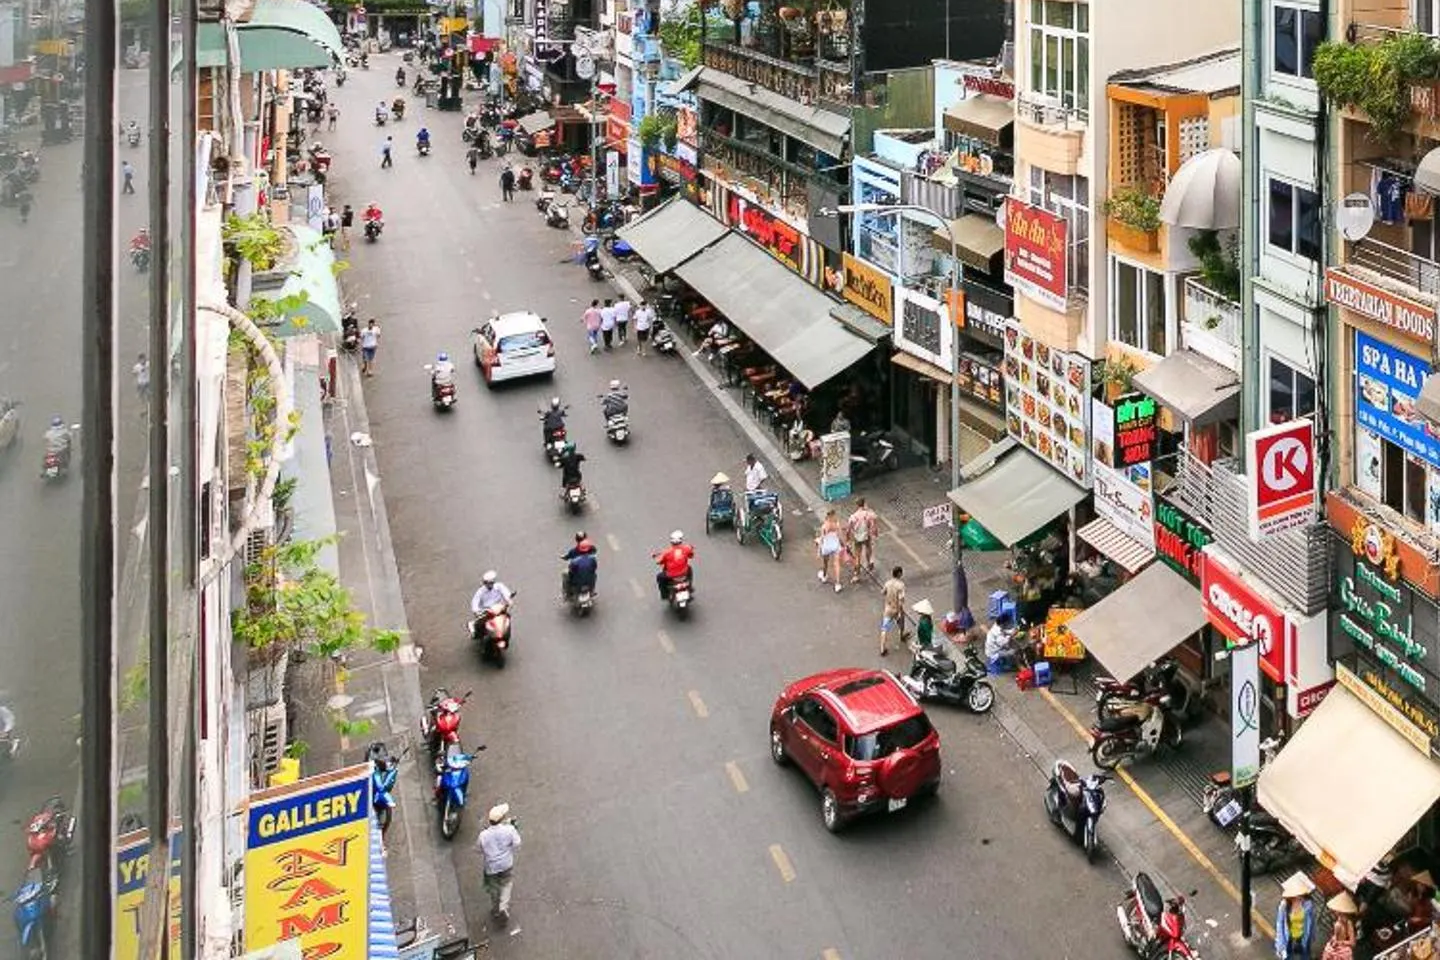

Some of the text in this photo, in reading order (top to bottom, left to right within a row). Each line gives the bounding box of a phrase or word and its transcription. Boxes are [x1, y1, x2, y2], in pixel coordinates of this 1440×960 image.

[1330, 278, 1433, 341] VEGETARIAN FOODS
[1362, 344, 1391, 376] SPA
[1394, 360, 1418, 389] HA
[1270, 442, 1308, 486] K
[1209, 583, 1253, 637] CIRCLE
[258, 790, 362, 838] GALLERY
